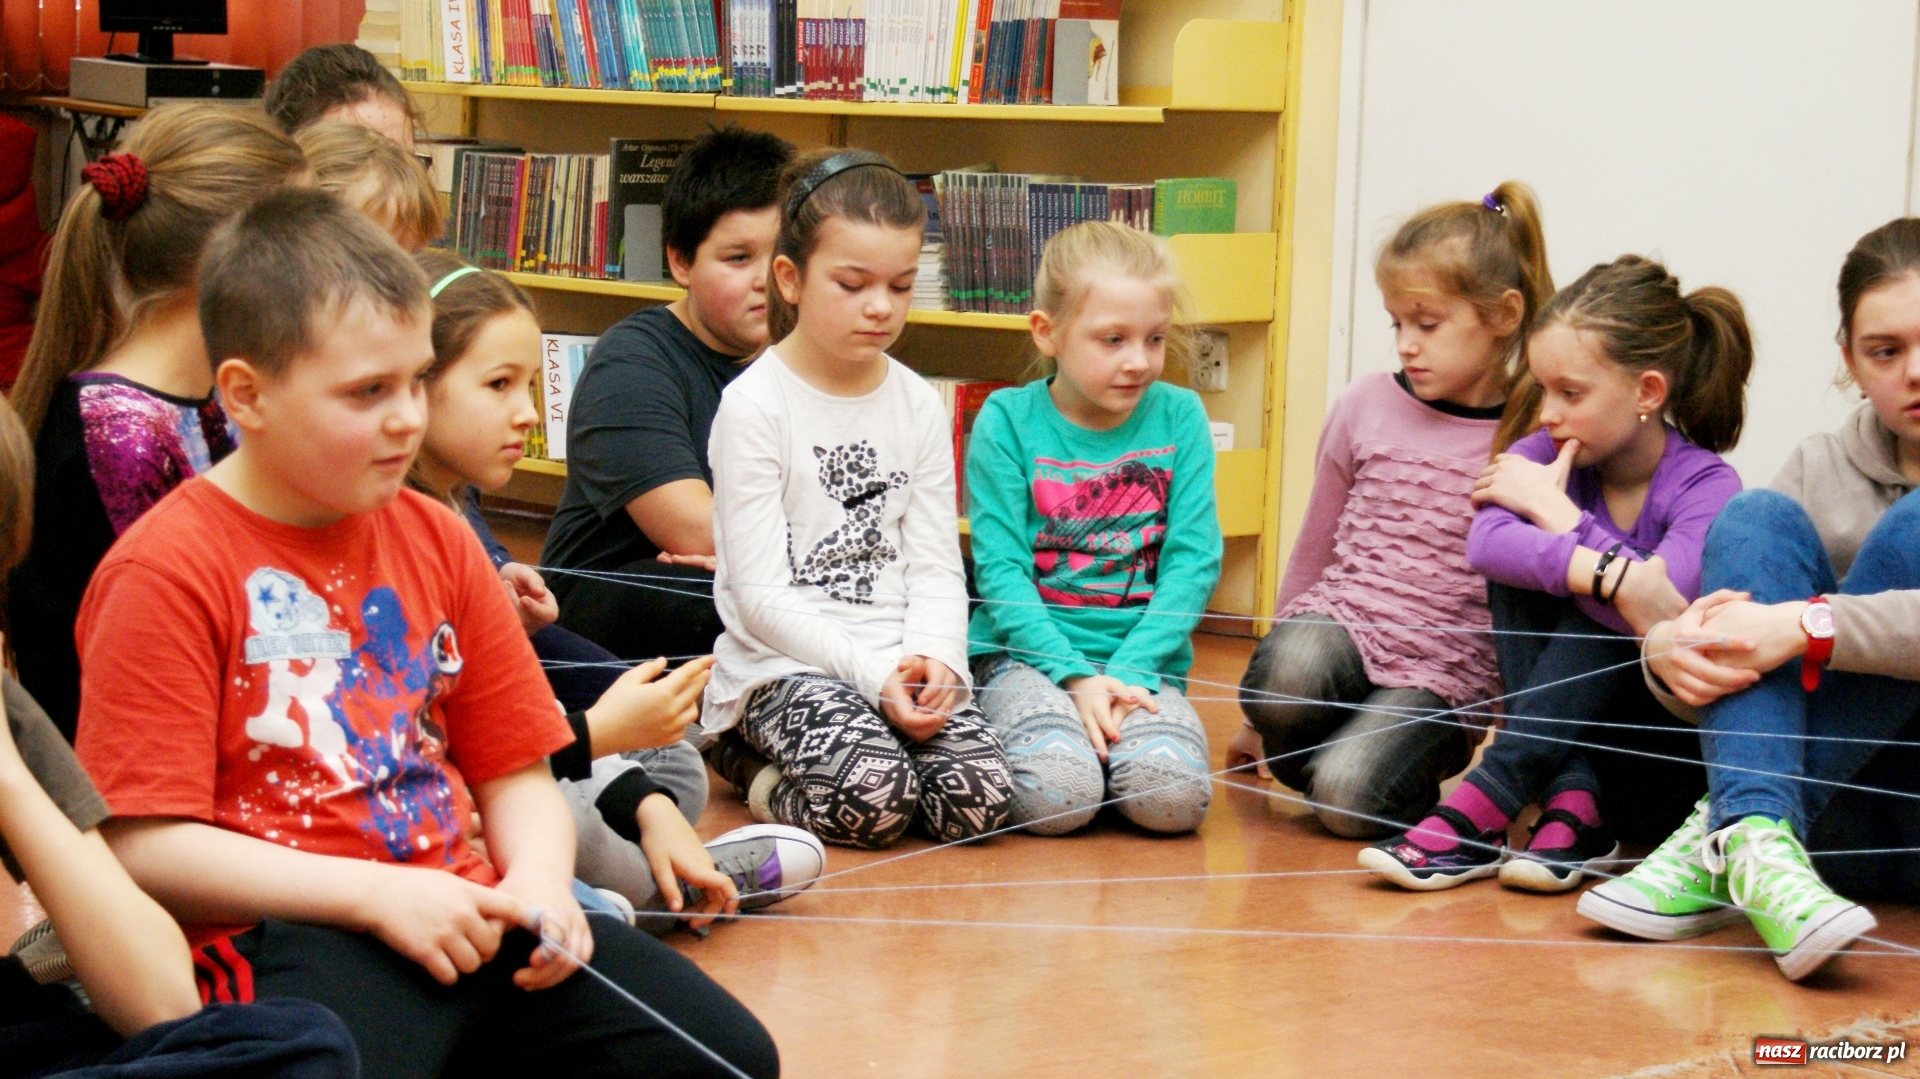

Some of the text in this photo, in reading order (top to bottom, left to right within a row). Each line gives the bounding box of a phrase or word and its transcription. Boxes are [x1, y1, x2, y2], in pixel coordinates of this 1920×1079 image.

[450, 19, 466, 75] KLASA
[640, 154, 682, 172] Legend
[619, 173, 670, 184] warszaw
[1177, 190, 1225, 204] HOBBIT
[547, 338, 564, 423] KLASA VI
[250, 632, 348, 660] REPORTER
